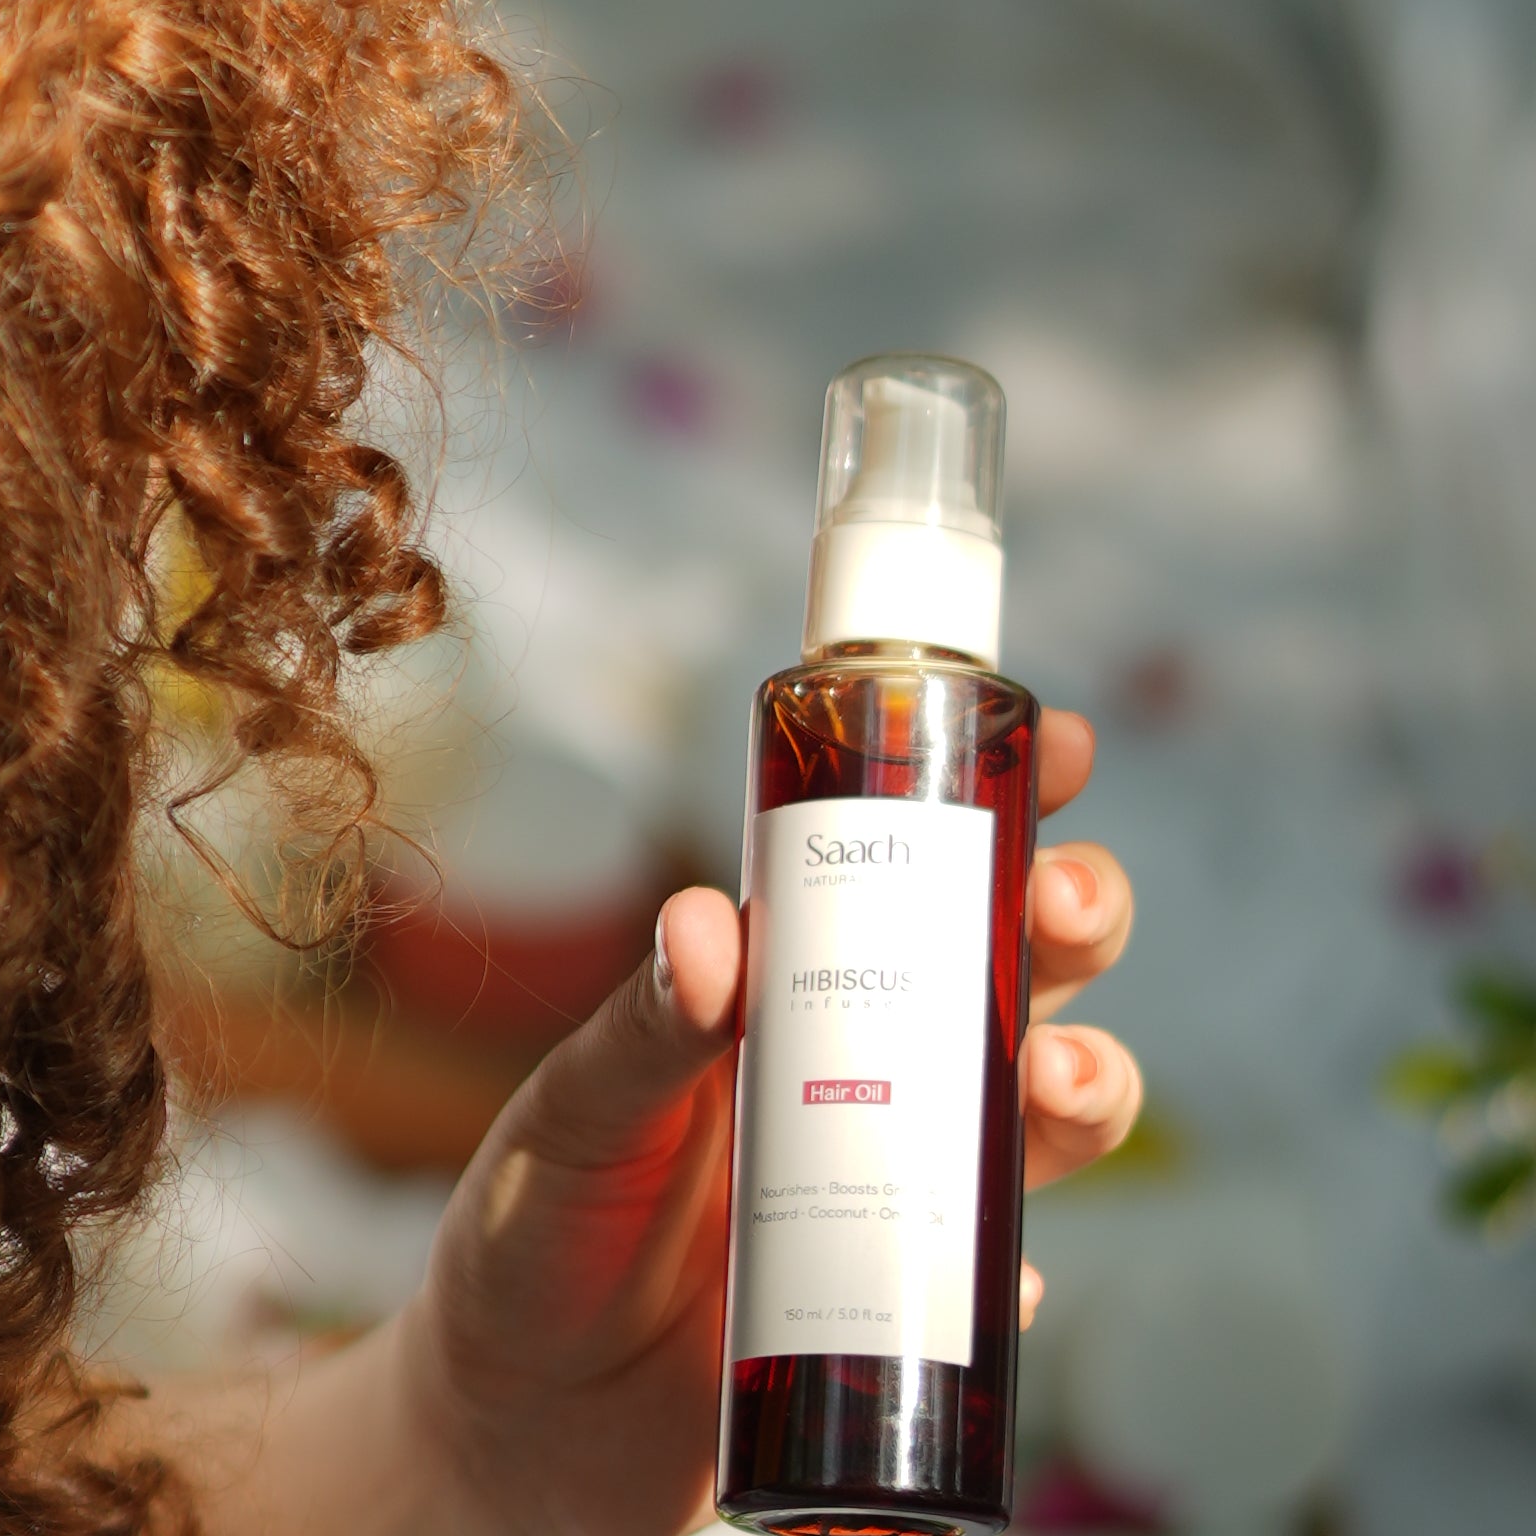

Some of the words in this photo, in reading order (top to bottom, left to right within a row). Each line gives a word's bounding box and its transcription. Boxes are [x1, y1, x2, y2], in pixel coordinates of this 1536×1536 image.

[792, 969, 912, 993] HIBISCUS
[810, 1084, 851, 1101] Hair
[855, 1083, 883, 1101] Oil
[760, 1183, 818, 1199] Nourishes
[829, 1181, 878, 1195] Boosts
[752, 1208, 798, 1224] Mustard
[808, 1206, 868, 1219] Coconut
[807, 1308, 822, 1321] ml
[875, 1312, 892, 1322] oz
